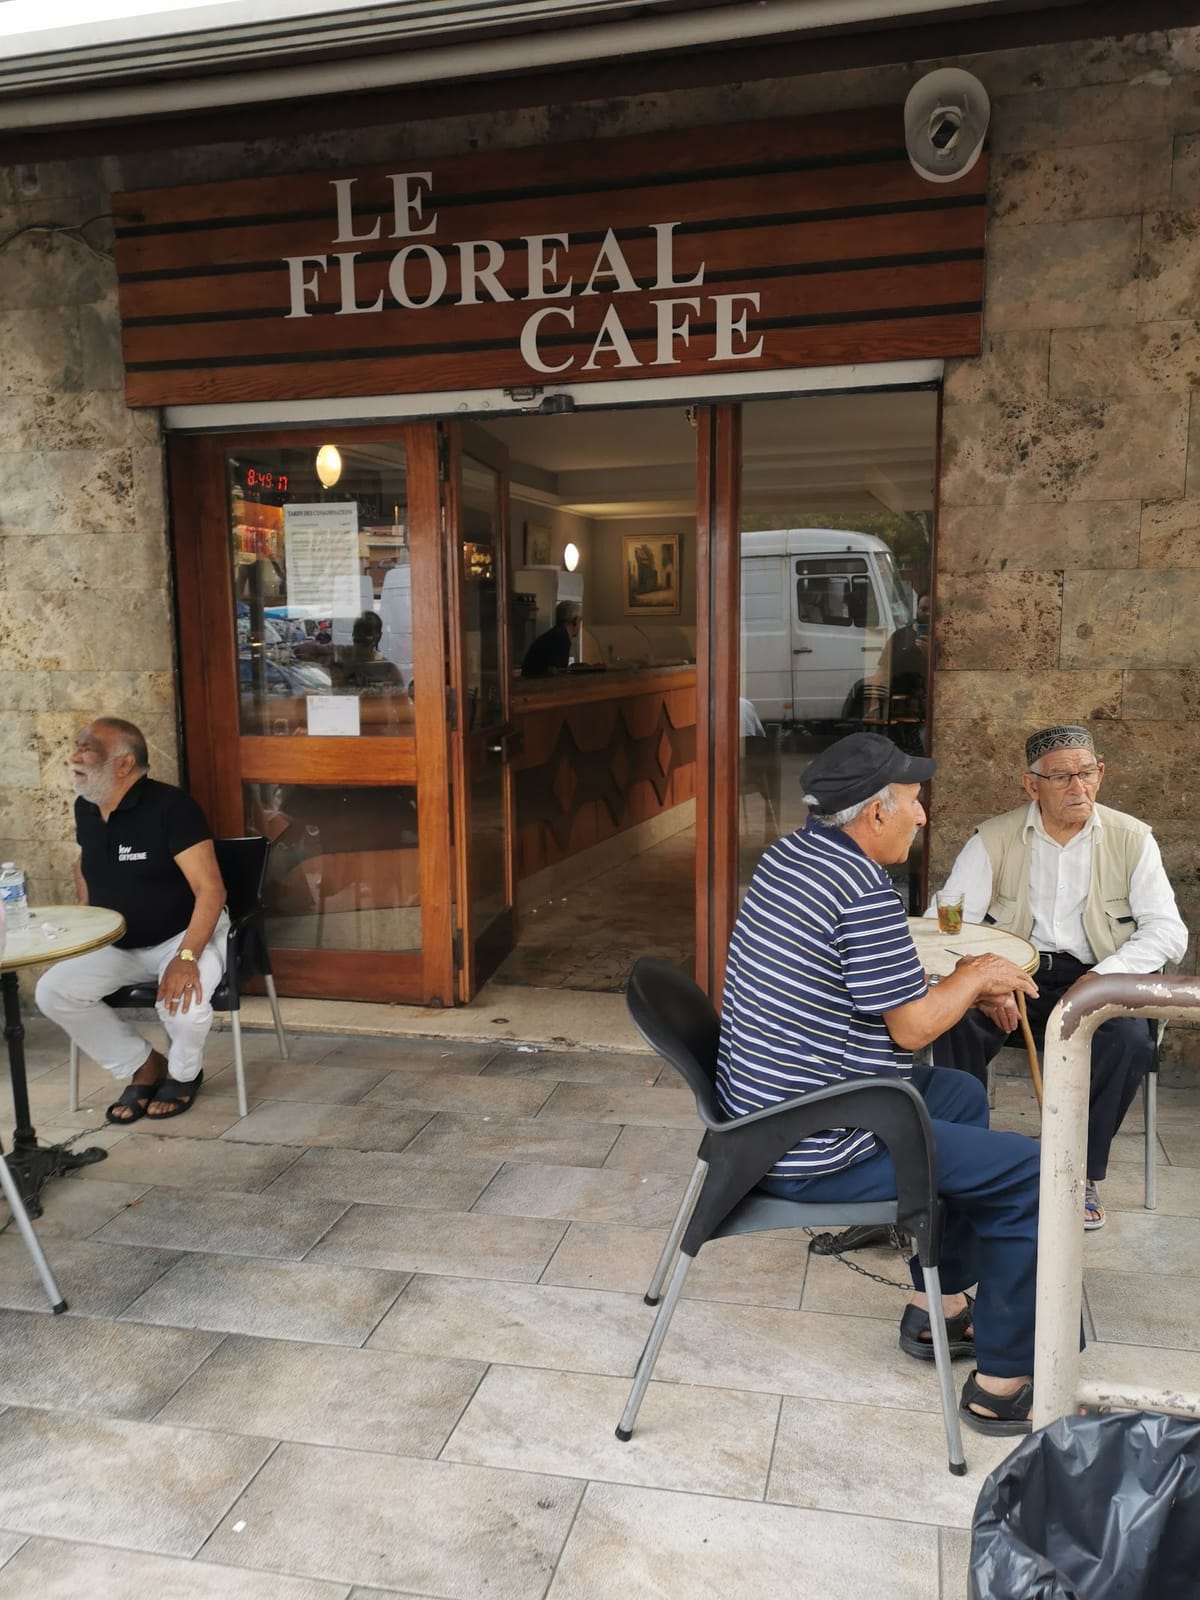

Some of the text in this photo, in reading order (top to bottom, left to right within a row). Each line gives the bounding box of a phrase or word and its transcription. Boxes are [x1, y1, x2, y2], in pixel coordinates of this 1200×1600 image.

[329, 170, 438, 243] LE
[282, 222, 706, 319] FLOREAL
[519, 292, 765, 374] CAFE
